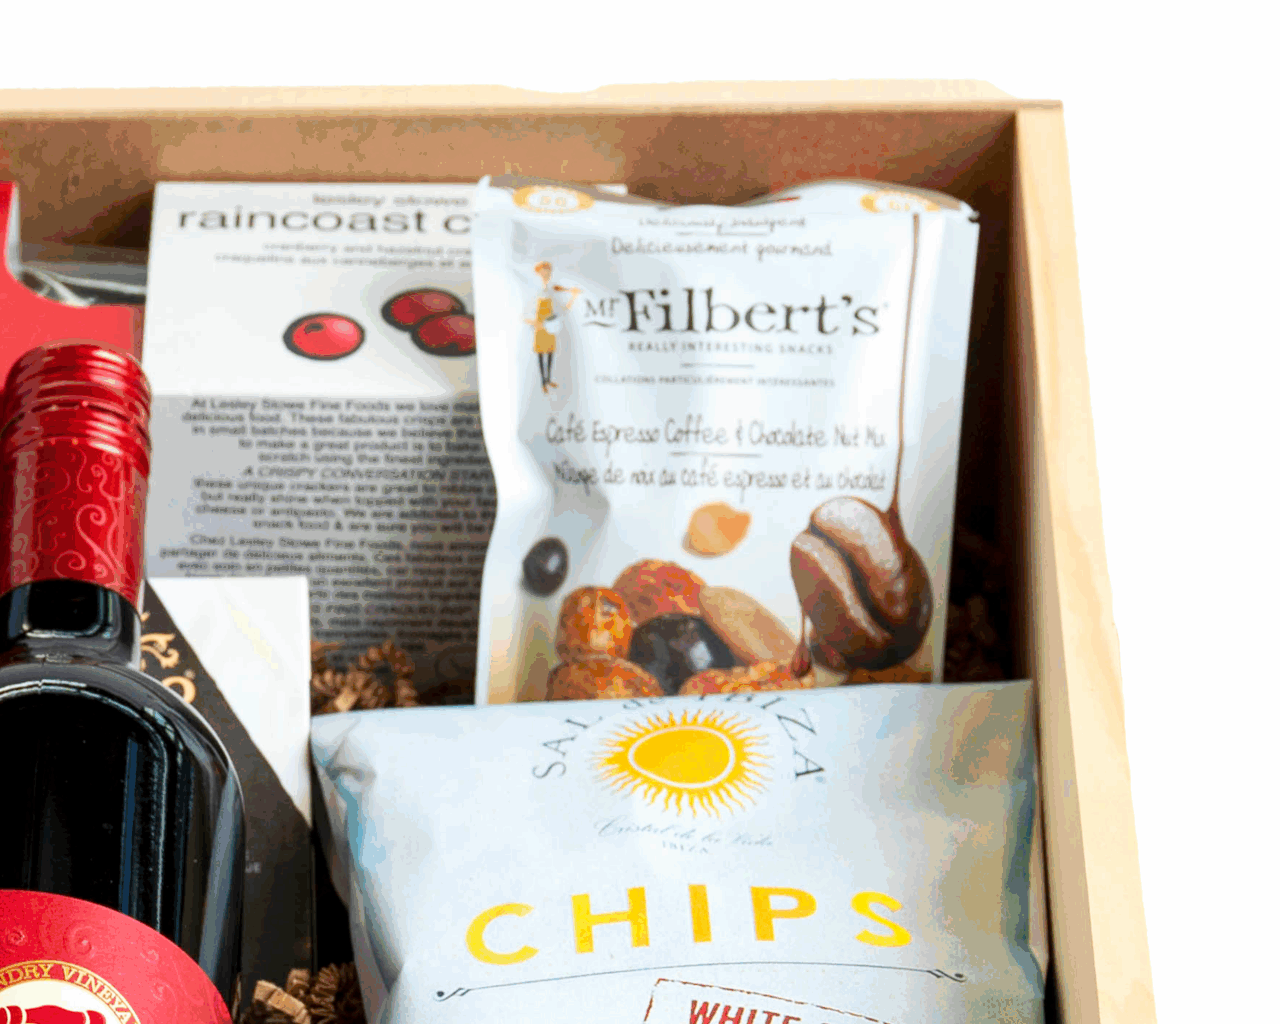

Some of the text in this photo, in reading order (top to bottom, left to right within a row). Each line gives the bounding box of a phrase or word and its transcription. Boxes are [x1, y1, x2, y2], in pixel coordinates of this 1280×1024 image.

[179, 205, 426, 233] raincoast
[620, 287, 880, 336] Filbert's
[628, 341, 835, 355] REALLY INTERESTING SNACKS
[465, 884, 913, 966] CHIPS
